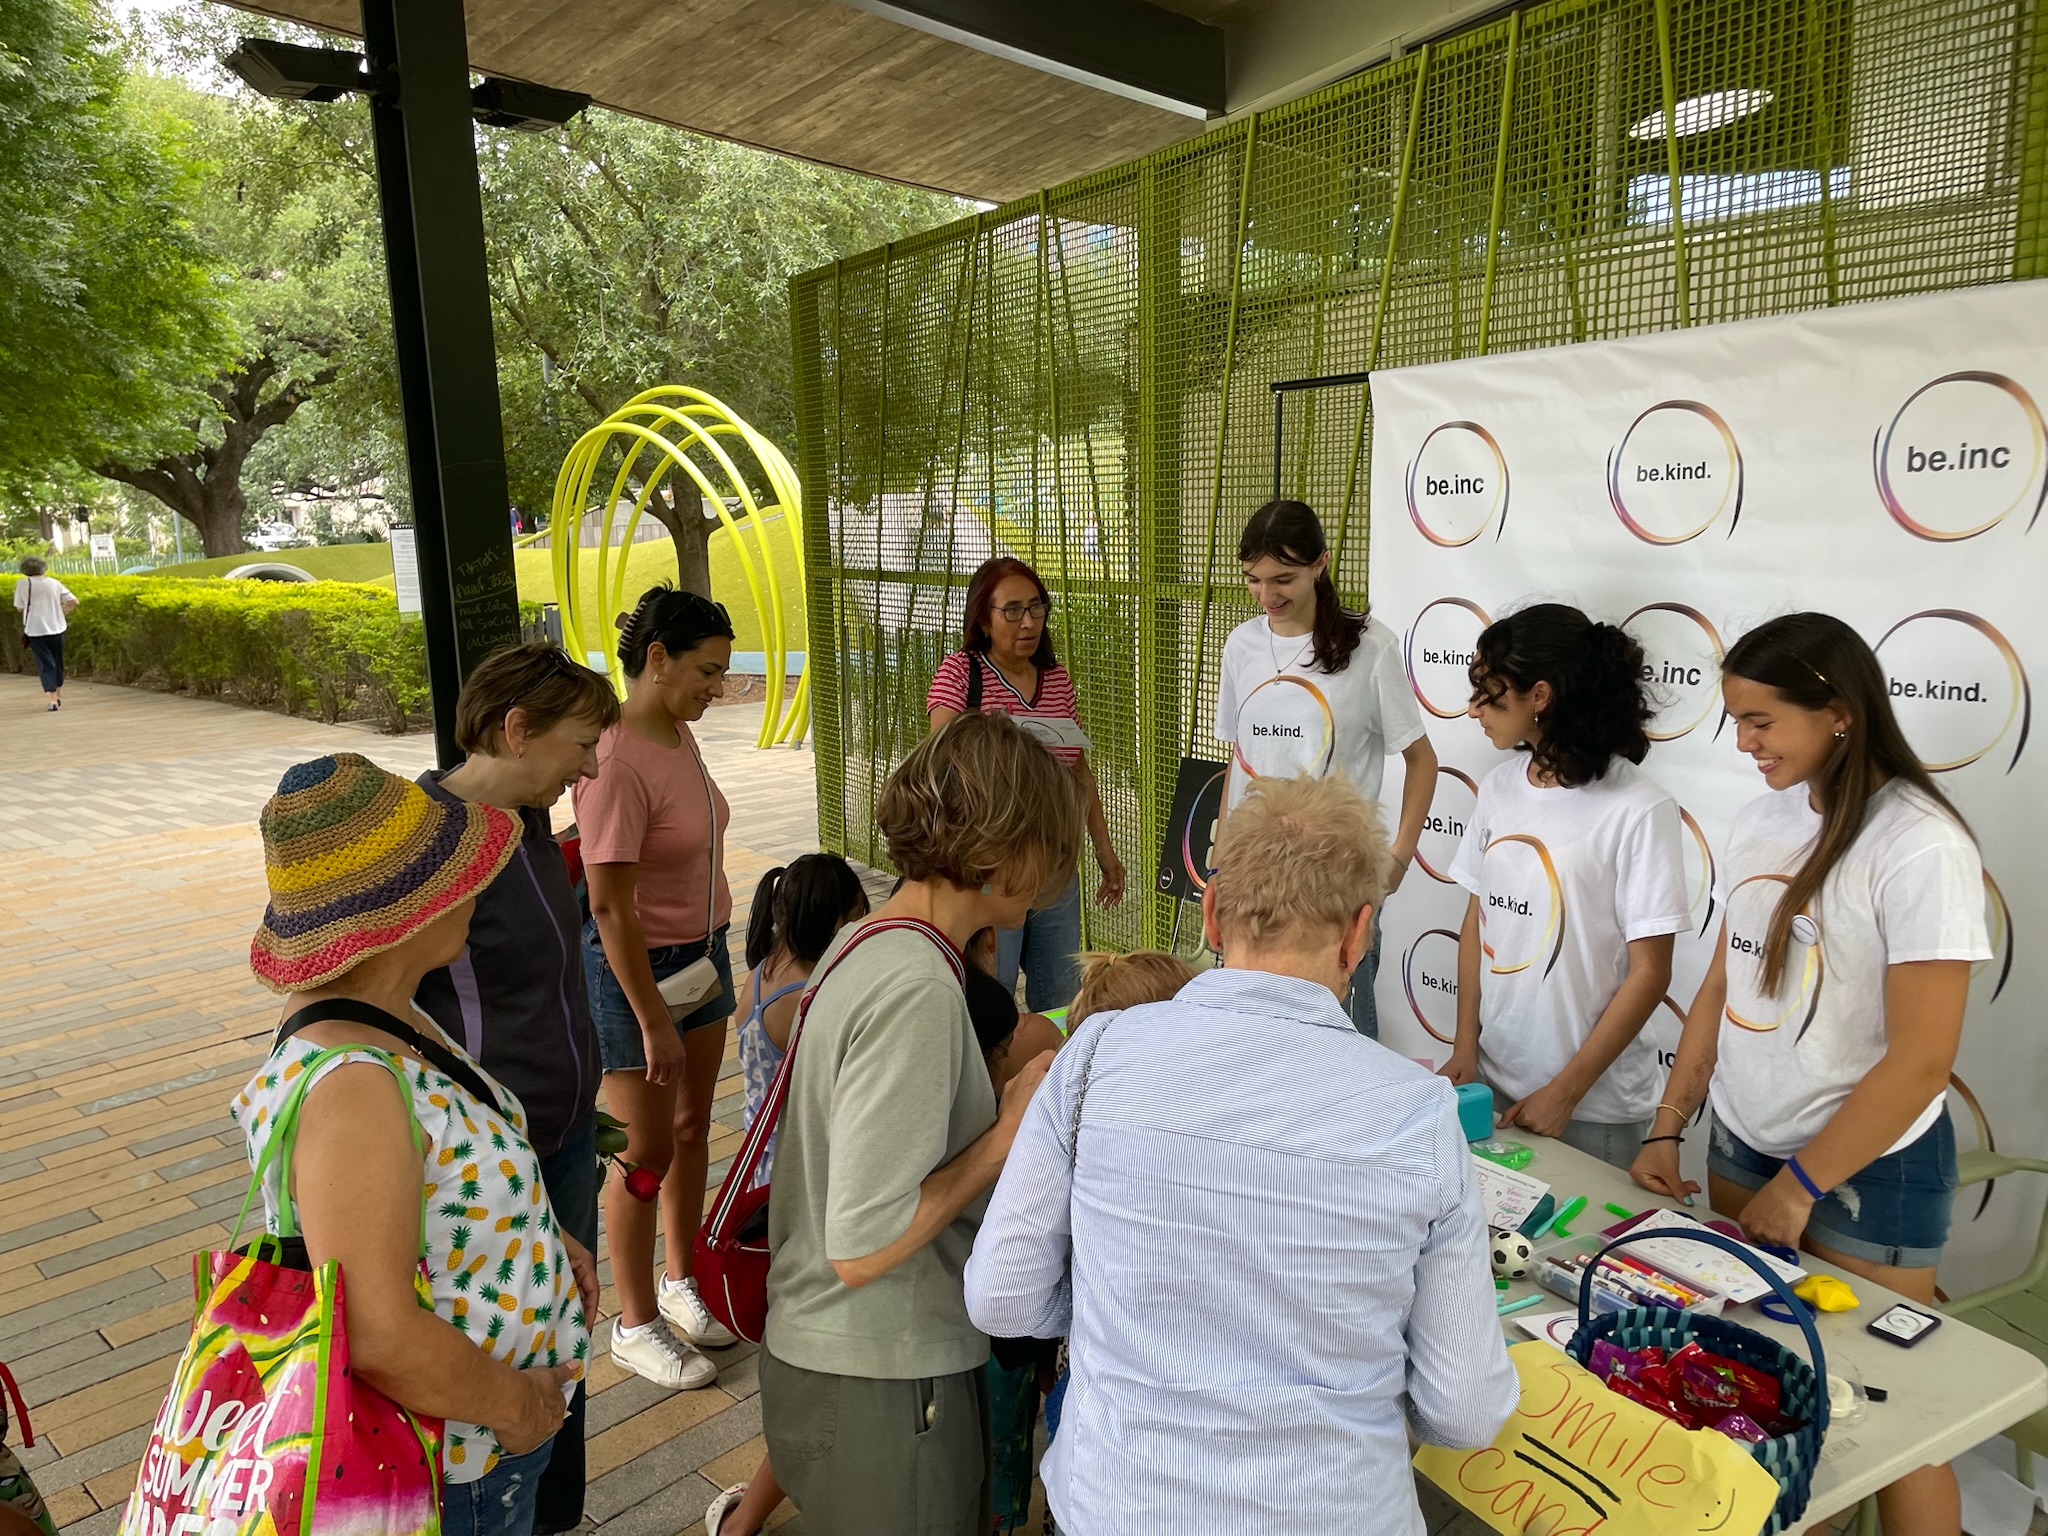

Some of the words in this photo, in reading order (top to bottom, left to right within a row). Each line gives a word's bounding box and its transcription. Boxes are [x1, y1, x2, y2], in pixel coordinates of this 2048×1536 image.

[1904, 442, 2011, 473] be.inc
[1636, 461, 1711, 482] be.kind.
[1426, 474, 1484, 495] be.inc
[1640, 660, 1702, 686] e.inc
[1889, 677, 1987, 703] be.kind.
[1252, 723, 1304, 738] be.kind.
[1423, 815, 1468, 838] be.in
[143, 1443, 274, 1512] SUMMER
